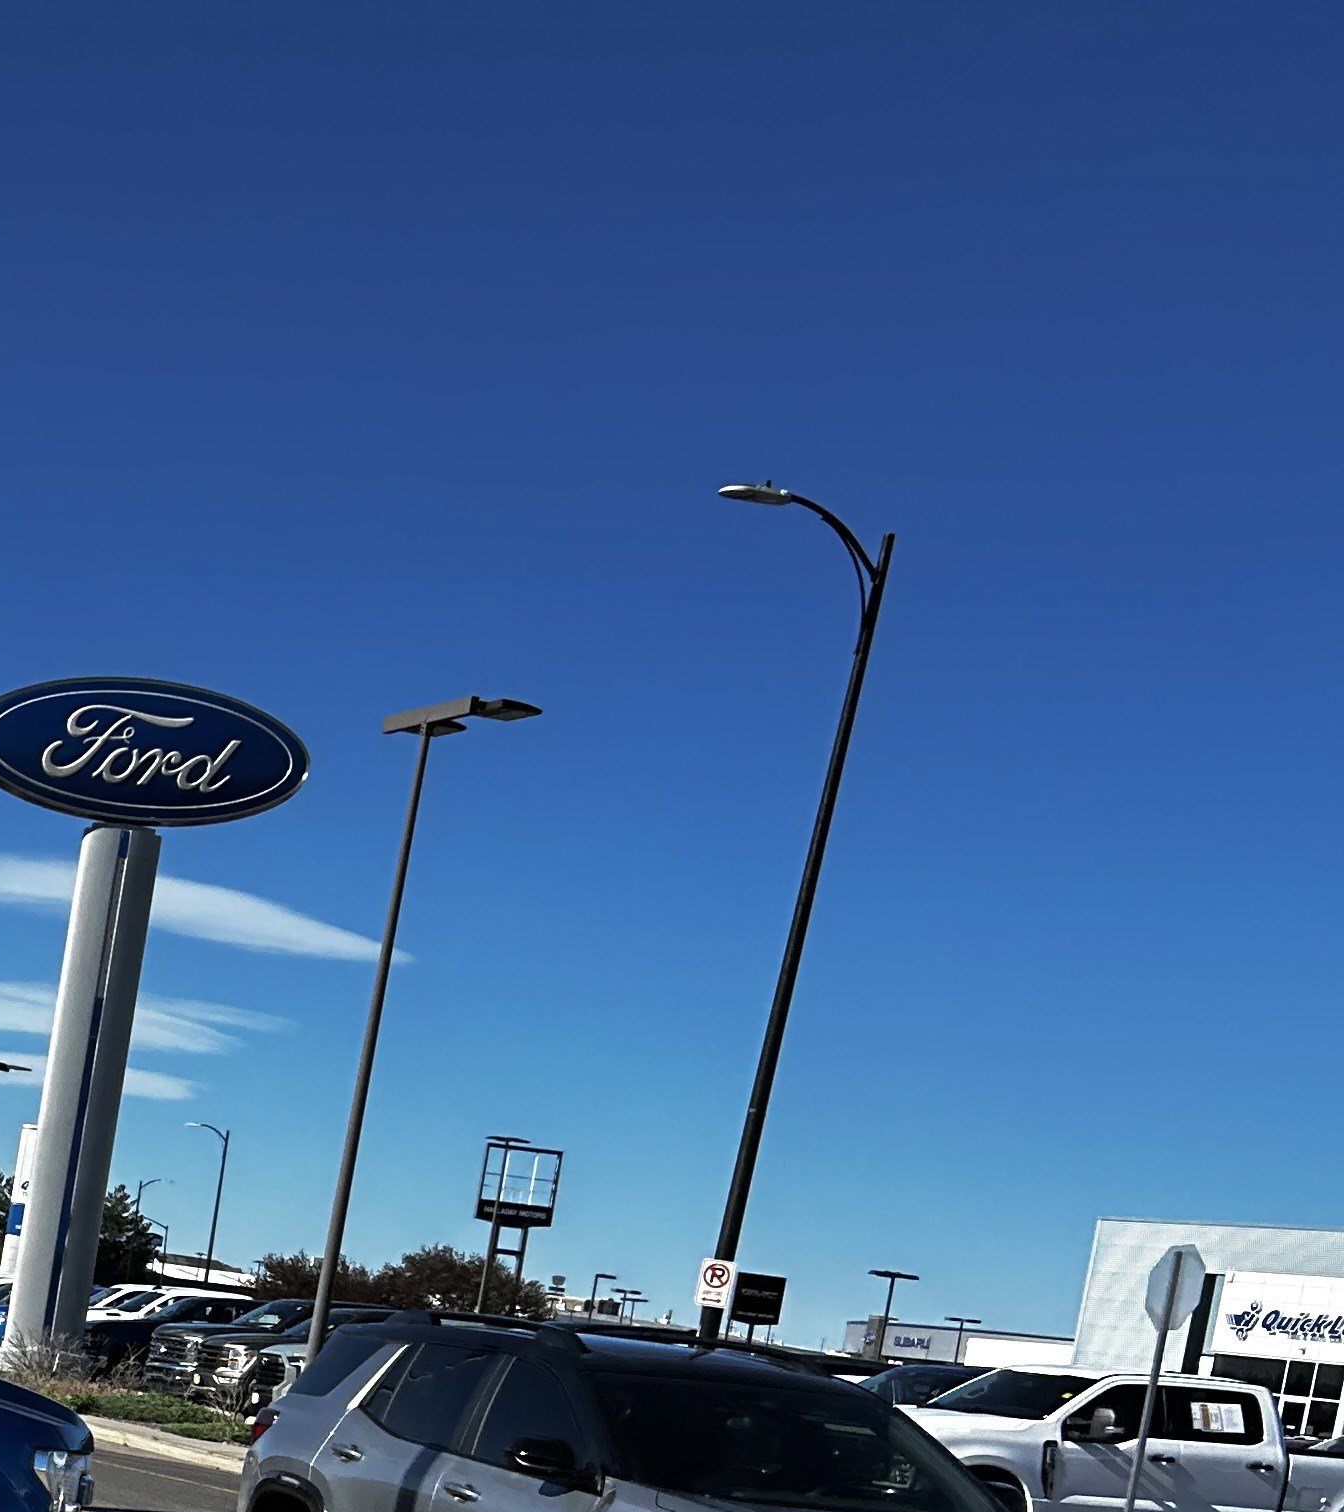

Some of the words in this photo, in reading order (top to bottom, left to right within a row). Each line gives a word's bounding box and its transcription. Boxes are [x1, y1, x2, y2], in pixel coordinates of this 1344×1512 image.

[41, 704, 242, 794] Ford
[483, 1205, 518, 1216] HALADAY
[1261, 1309, 1328, 1334] Quick
[893, 1335, 931, 1350] SUBARU
